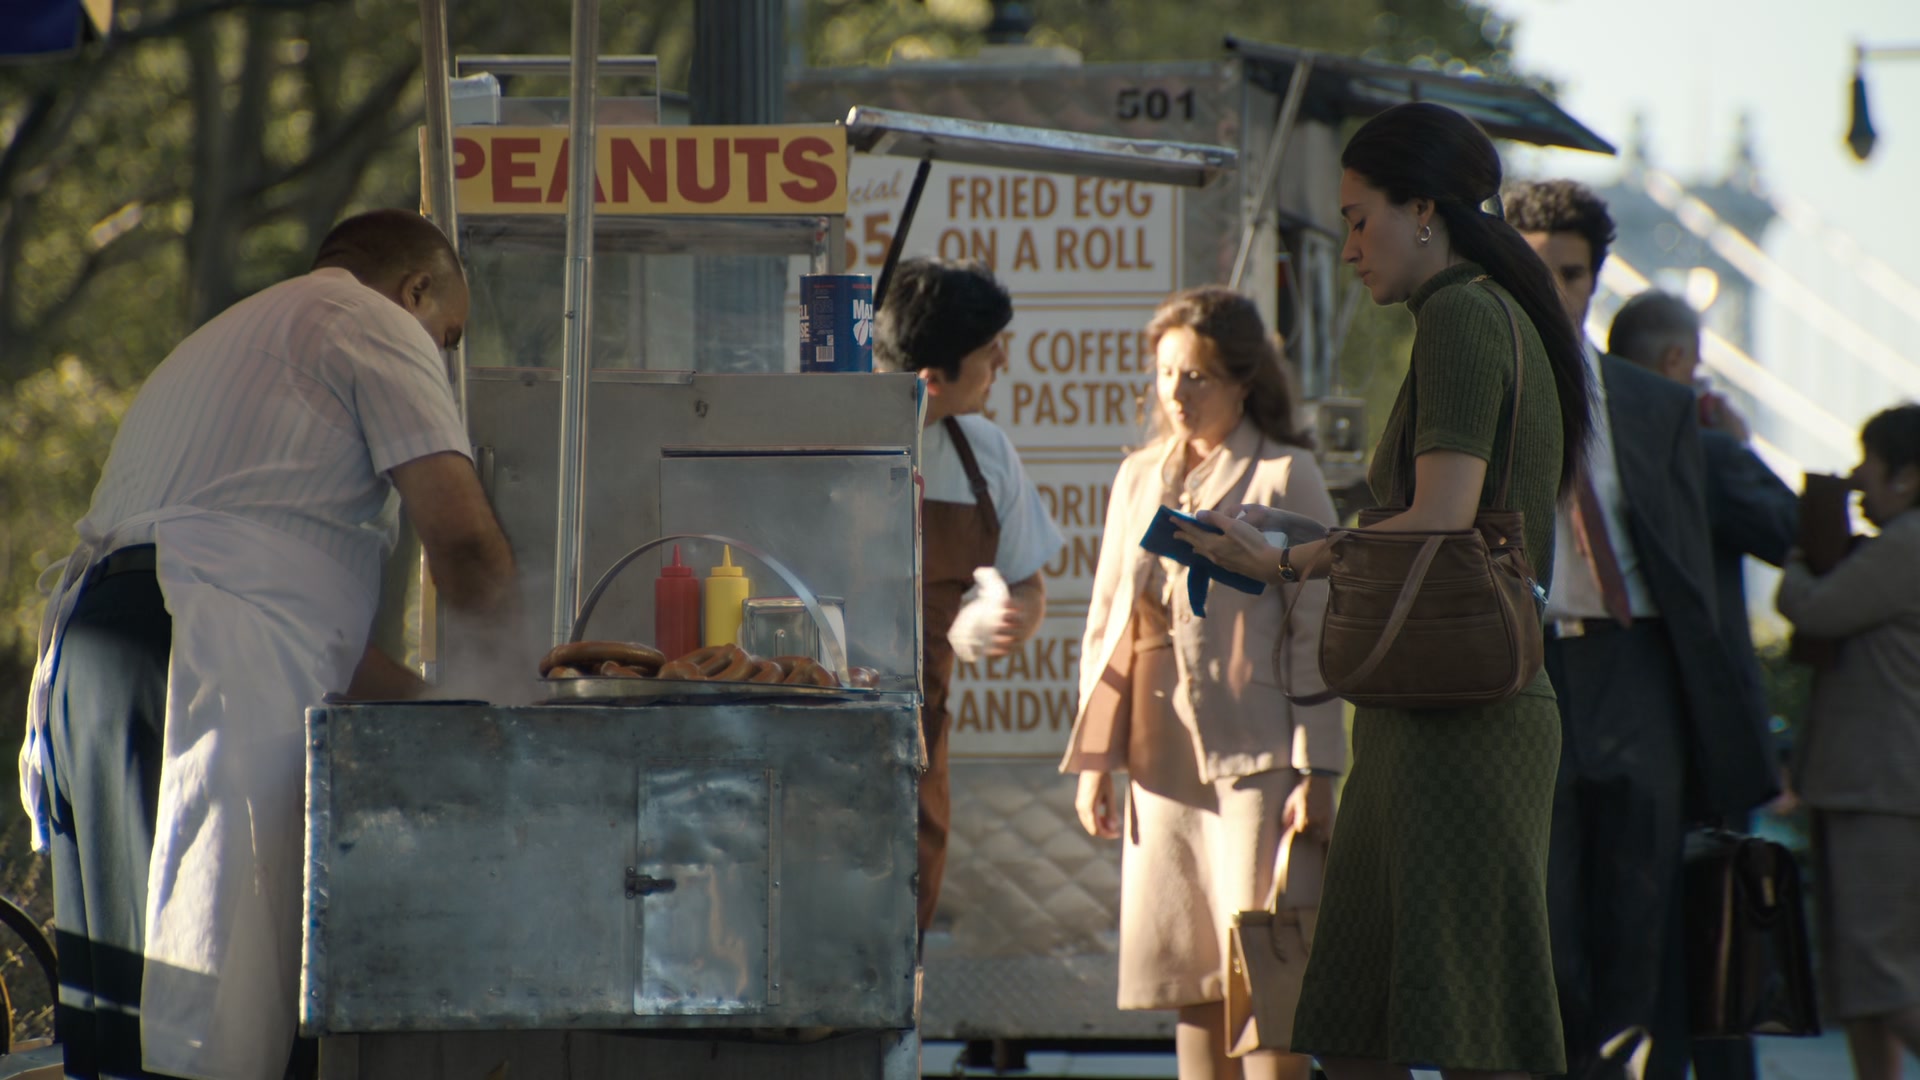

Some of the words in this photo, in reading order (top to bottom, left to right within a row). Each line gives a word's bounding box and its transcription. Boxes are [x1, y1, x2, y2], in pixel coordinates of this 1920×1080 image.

[1117, 87, 1195, 121] 501
[453, 137, 837, 203] PEANUTS
[850, 168, 903, 206] cial
[948, 176, 1057, 220] FRIED
[1074, 176, 1153, 219] EGG
[938, 228, 998, 271] ON
[1013, 228, 1040, 271] A
[1055, 228, 1154, 271] ROLL
[1028, 330, 1153, 373] COFFEE
[1013, 382, 1153, 426] PASTRY
[953, 637, 1079, 680] REAKF
[949, 688, 1078, 732] ANDW
